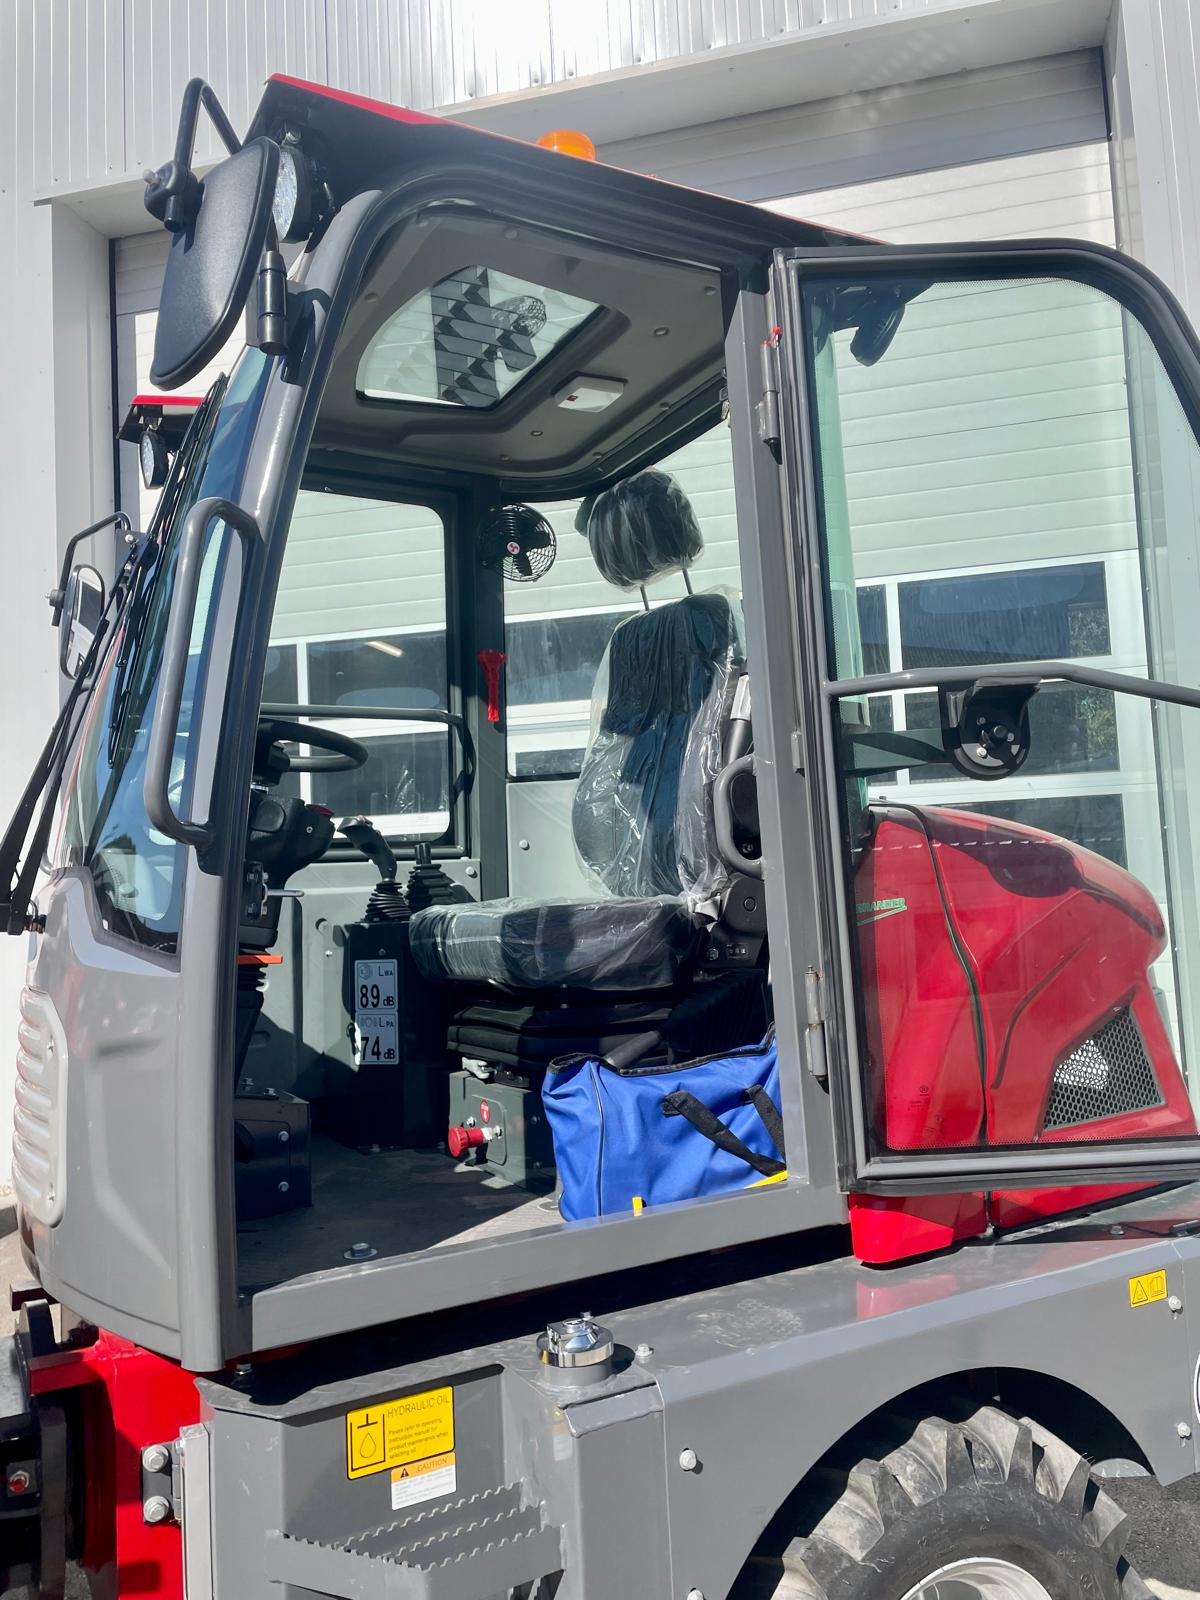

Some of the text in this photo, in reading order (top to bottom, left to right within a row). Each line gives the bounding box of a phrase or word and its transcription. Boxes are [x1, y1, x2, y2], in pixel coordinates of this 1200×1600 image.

[360, 984, 395, 1008] 89 dB
[360, 1036, 396, 1061] 74 dB
[387, 1394, 450, 1418] HYDRAULIC OIL
[417, 1457, 447, 1472] CAUTION
